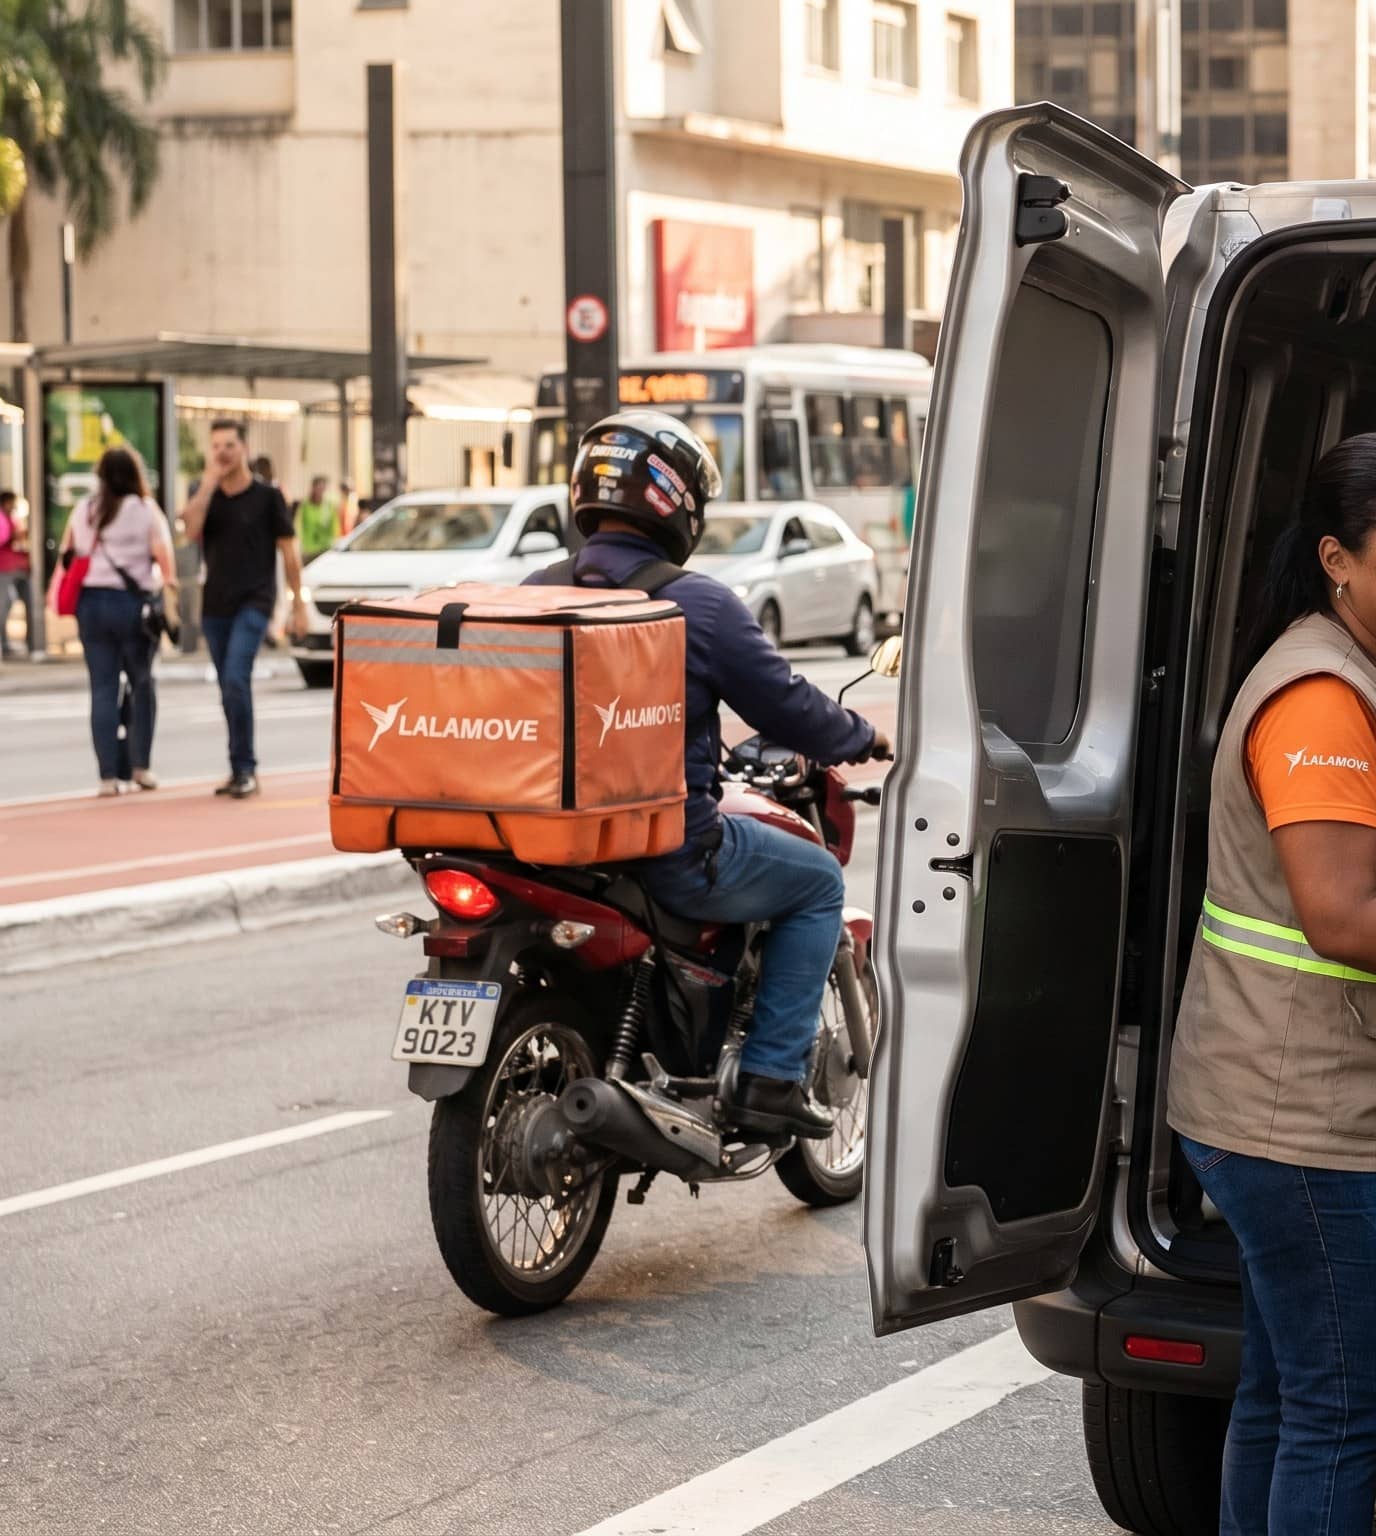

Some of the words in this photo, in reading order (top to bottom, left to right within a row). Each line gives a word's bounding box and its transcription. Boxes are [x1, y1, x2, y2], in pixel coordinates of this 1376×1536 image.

[399, 714, 539, 742] LALAMOVE
[615, 701, 682, 731] LALAMOVE
[1302, 754, 1369, 772] LALAMOVE
[419, 999, 476, 1027] KTV
[402, 1027, 477, 1057] 9023
